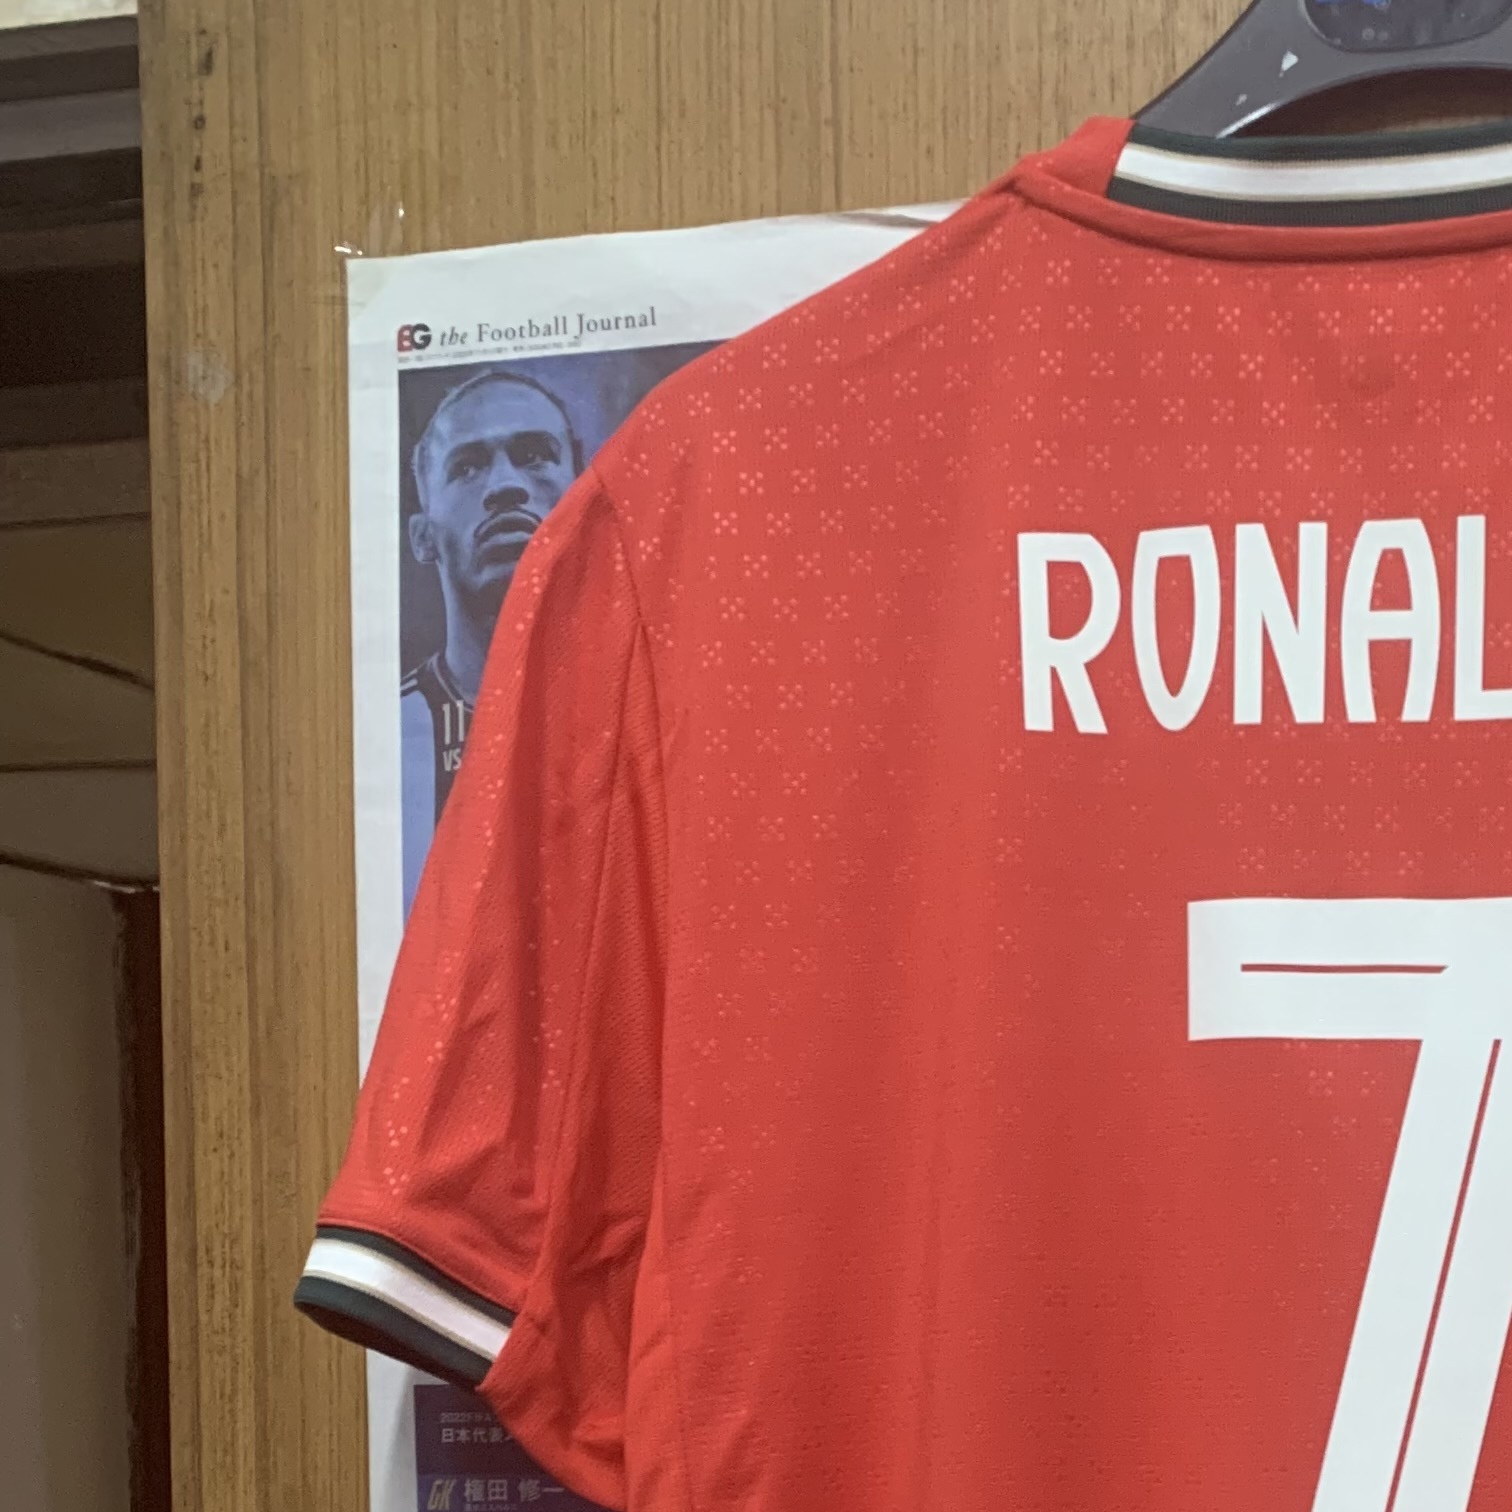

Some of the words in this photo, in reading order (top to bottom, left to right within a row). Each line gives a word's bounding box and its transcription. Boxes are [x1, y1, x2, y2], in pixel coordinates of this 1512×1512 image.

[439, 326, 469, 346] the
[477, 314, 569, 343] Football
[575, 305, 657, 340] Journal
[442, 701, 465, 745] 11
[440, 1428, 513, 1444] 日本代表
[426, 1479, 458, 1511] GK
